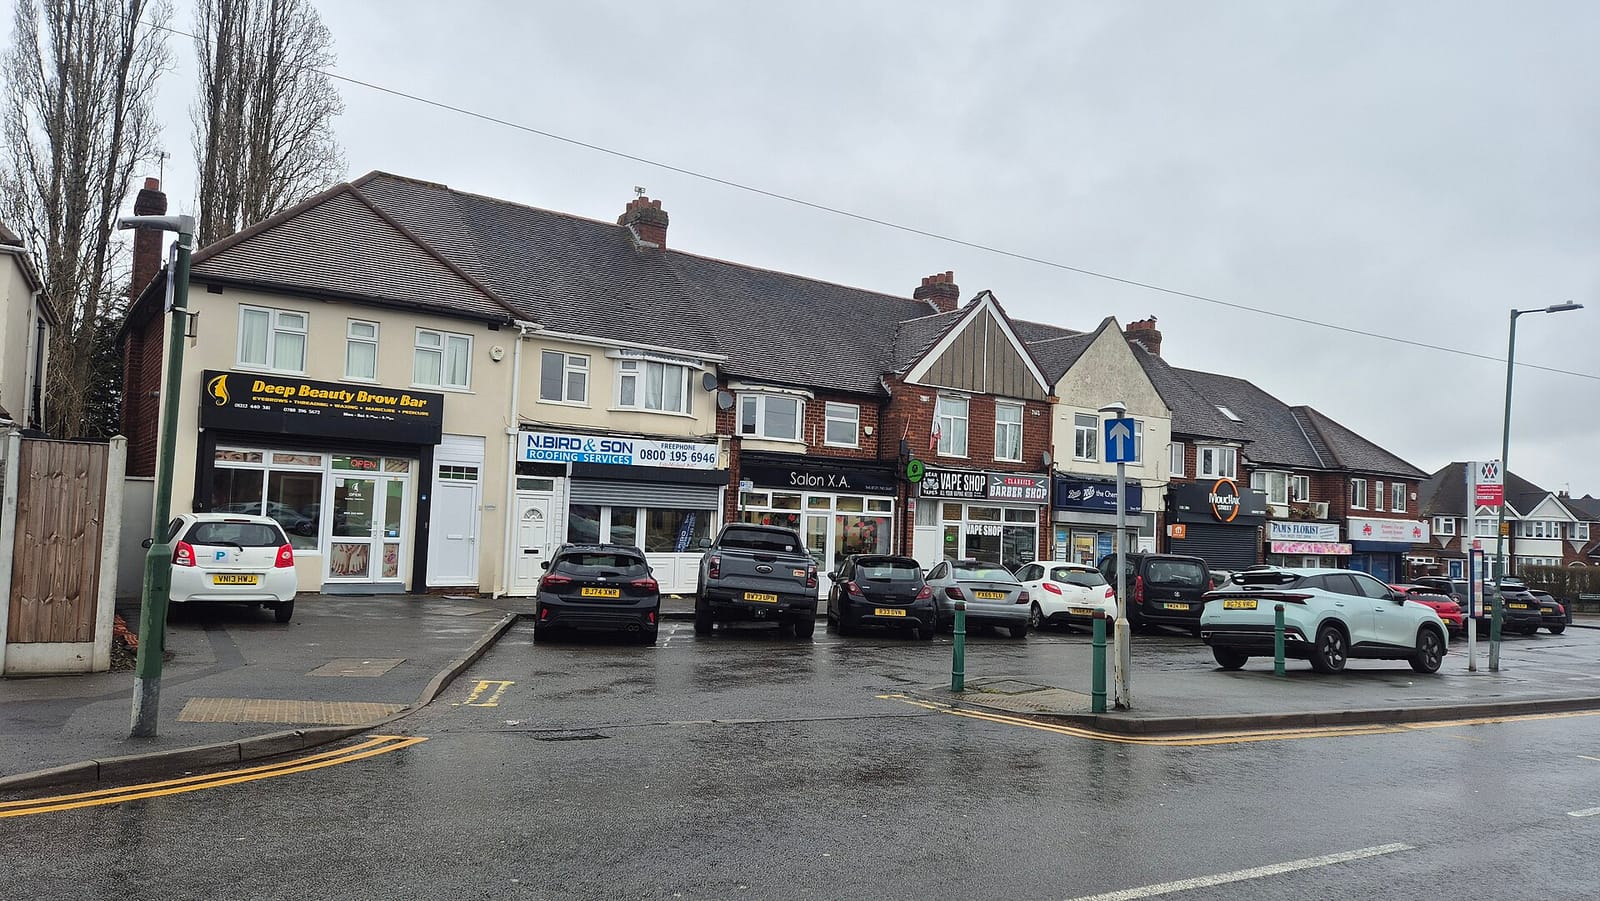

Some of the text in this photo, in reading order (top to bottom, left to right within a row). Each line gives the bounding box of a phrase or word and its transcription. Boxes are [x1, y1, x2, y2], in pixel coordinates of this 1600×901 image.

[252, 380, 428, 408] Deep Beauty Brow Bar
[252, 396, 289, 404] EYEBROWS
[294, 399, 329, 407] THREADING
[527, 434, 633, 454] N.BIRD & SON
[660, 442, 696, 451] FREEPHONE
[529, 450, 630, 464] ROOFING SERVICES
[640, 449, 715, 463] 0800 195 6946
[350, 459, 377, 469] OPEN
[790, 471, 851, 488] Salon X.A.
[940, 472, 986, 492] VAPE SHOP
[990, 485, 1047, 499] BARBER SHOP
[966, 524, 1001, 537] VAPE SHOP
[1293, 525, 1319, 535] FLORIST
[216, 551, 226, 560] P
[218, 575, 236, 583] VN13
